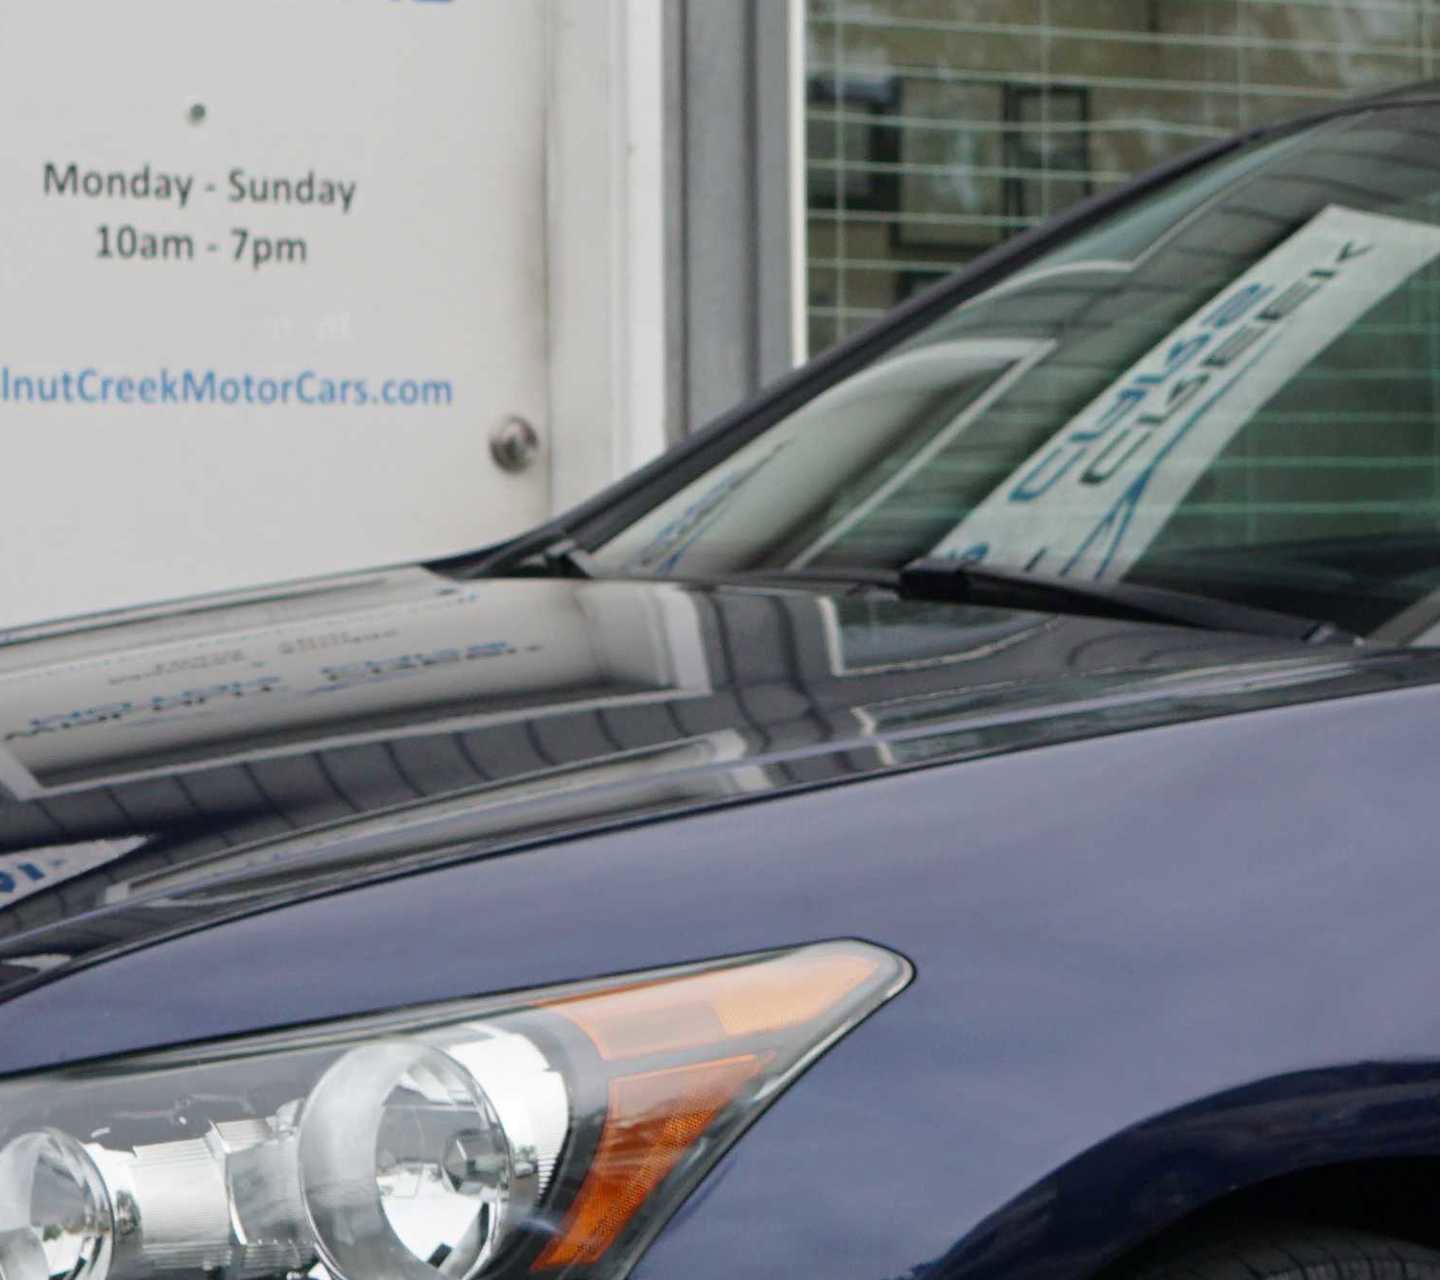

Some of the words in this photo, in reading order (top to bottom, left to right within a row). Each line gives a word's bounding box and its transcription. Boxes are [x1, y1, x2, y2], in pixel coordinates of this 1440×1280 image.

[42, 161, 194, 208] Monday
[227, 169, 357, 214] Sunday
[96, 223, 195, 260] 10am
[230, 227, 308, 271] 7pm
